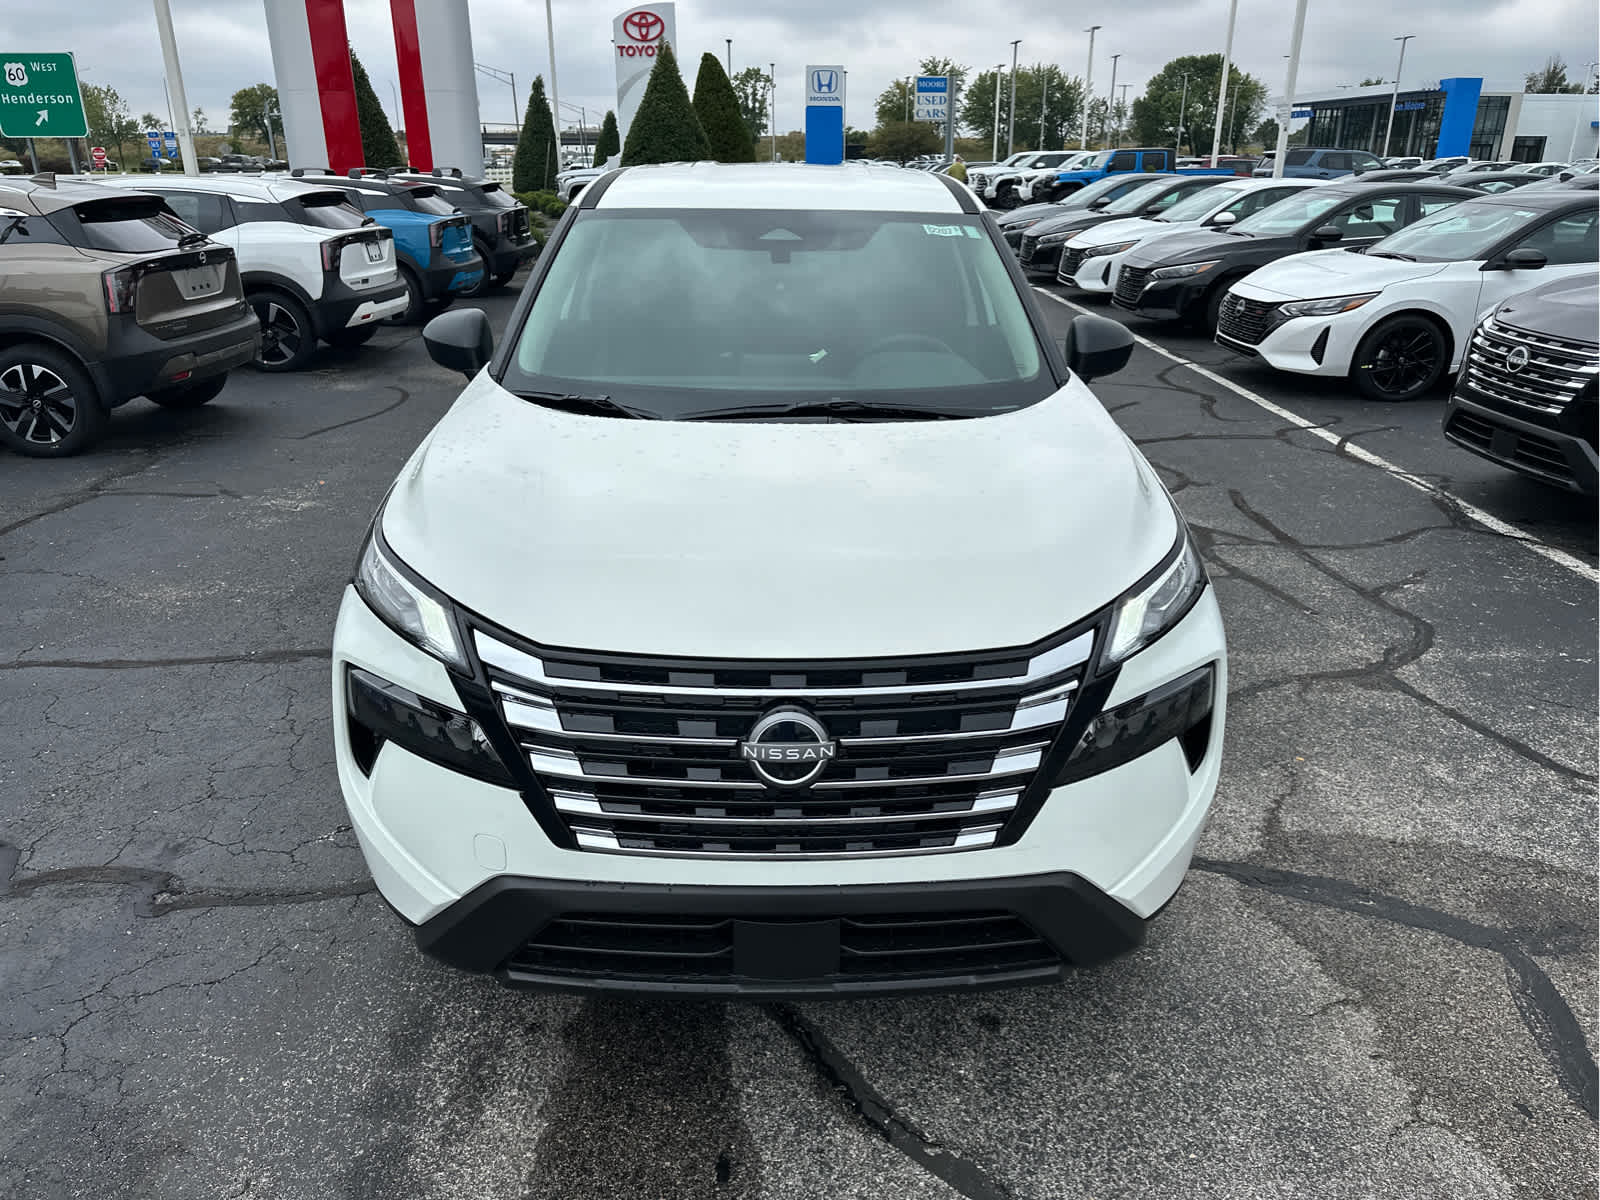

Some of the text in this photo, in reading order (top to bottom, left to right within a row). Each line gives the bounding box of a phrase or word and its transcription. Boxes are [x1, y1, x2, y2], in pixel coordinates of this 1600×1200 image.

[617, 45, 660, 57] TOYO
[30, 61, 57, 72] WEST
[7, 67, 25, 81] 60
[918, 79, 946, 89] MOORE
[1, 93, 74, 105] Henderson
[916, 95, 947, 106] USED
[915, 108, 946, 119] CARS
[743, 745, 834, 760] NISSAN
